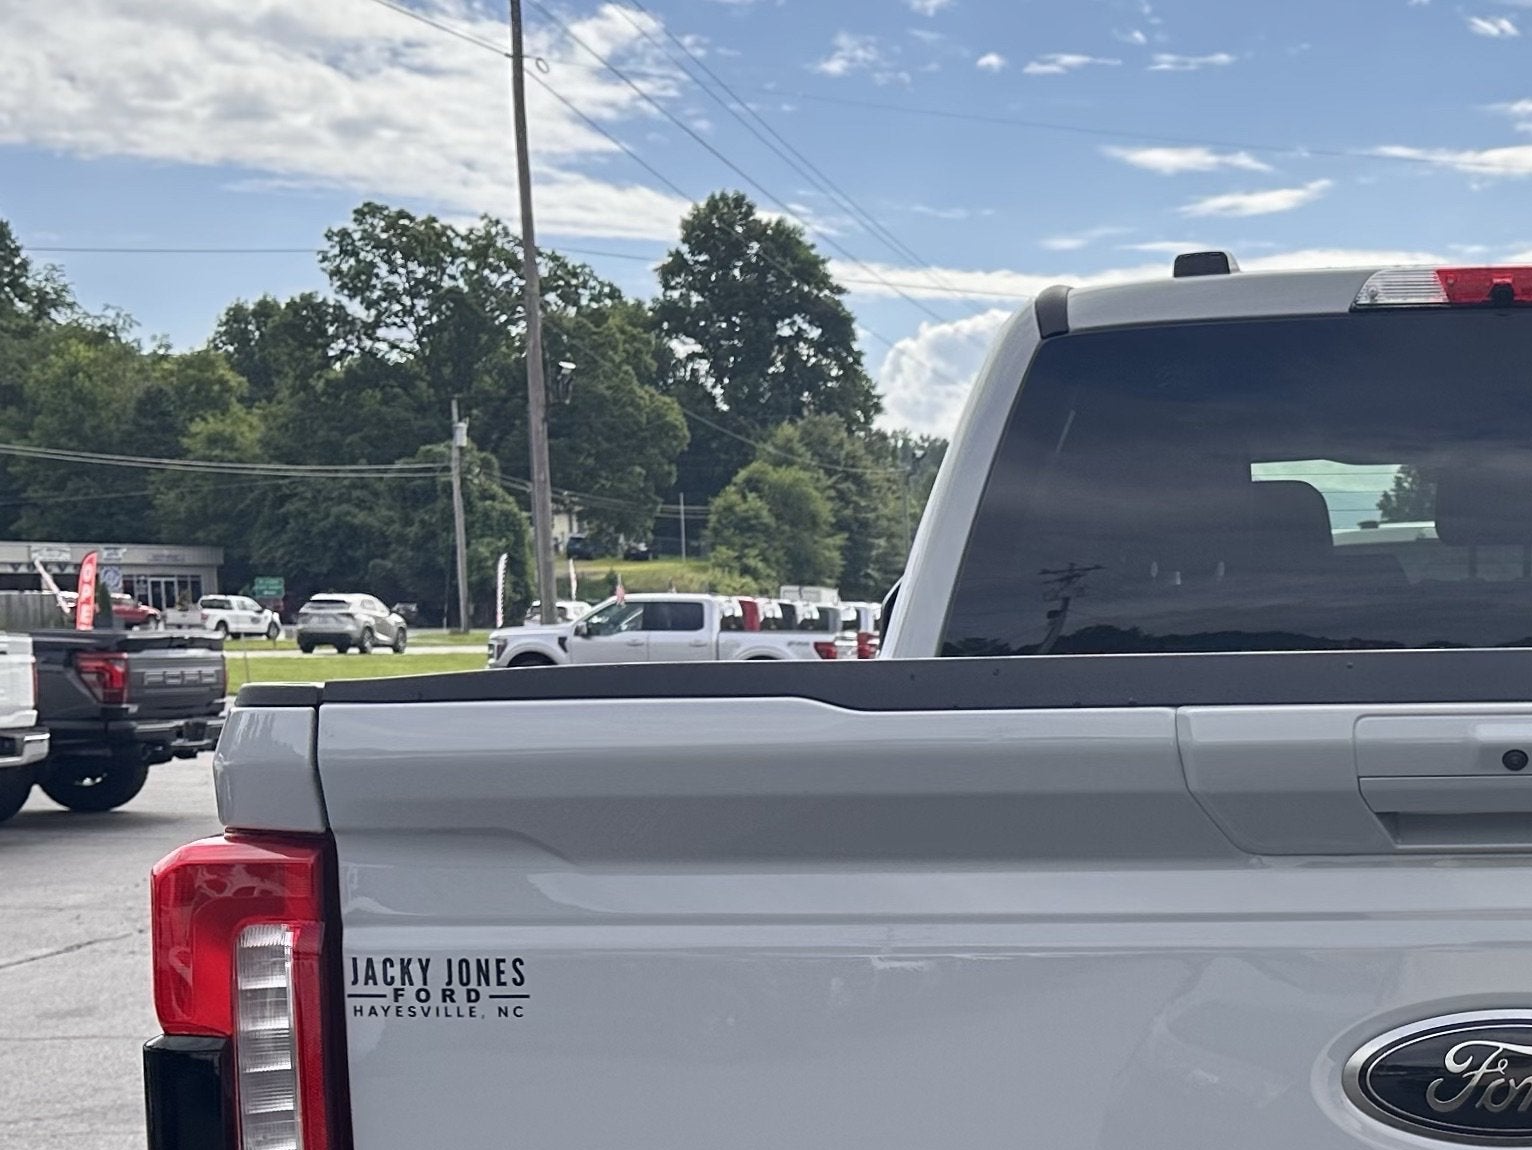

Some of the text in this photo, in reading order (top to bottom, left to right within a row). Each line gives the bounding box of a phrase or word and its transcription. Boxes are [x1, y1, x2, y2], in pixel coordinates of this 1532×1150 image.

[77, 562, 96, 631] OPE
[351, 957, 525, 987] JACKY JONES
[393, 988, 481, 1003] FORD
[353, 1005, 524, 1019] HAYESVILLE, NC
